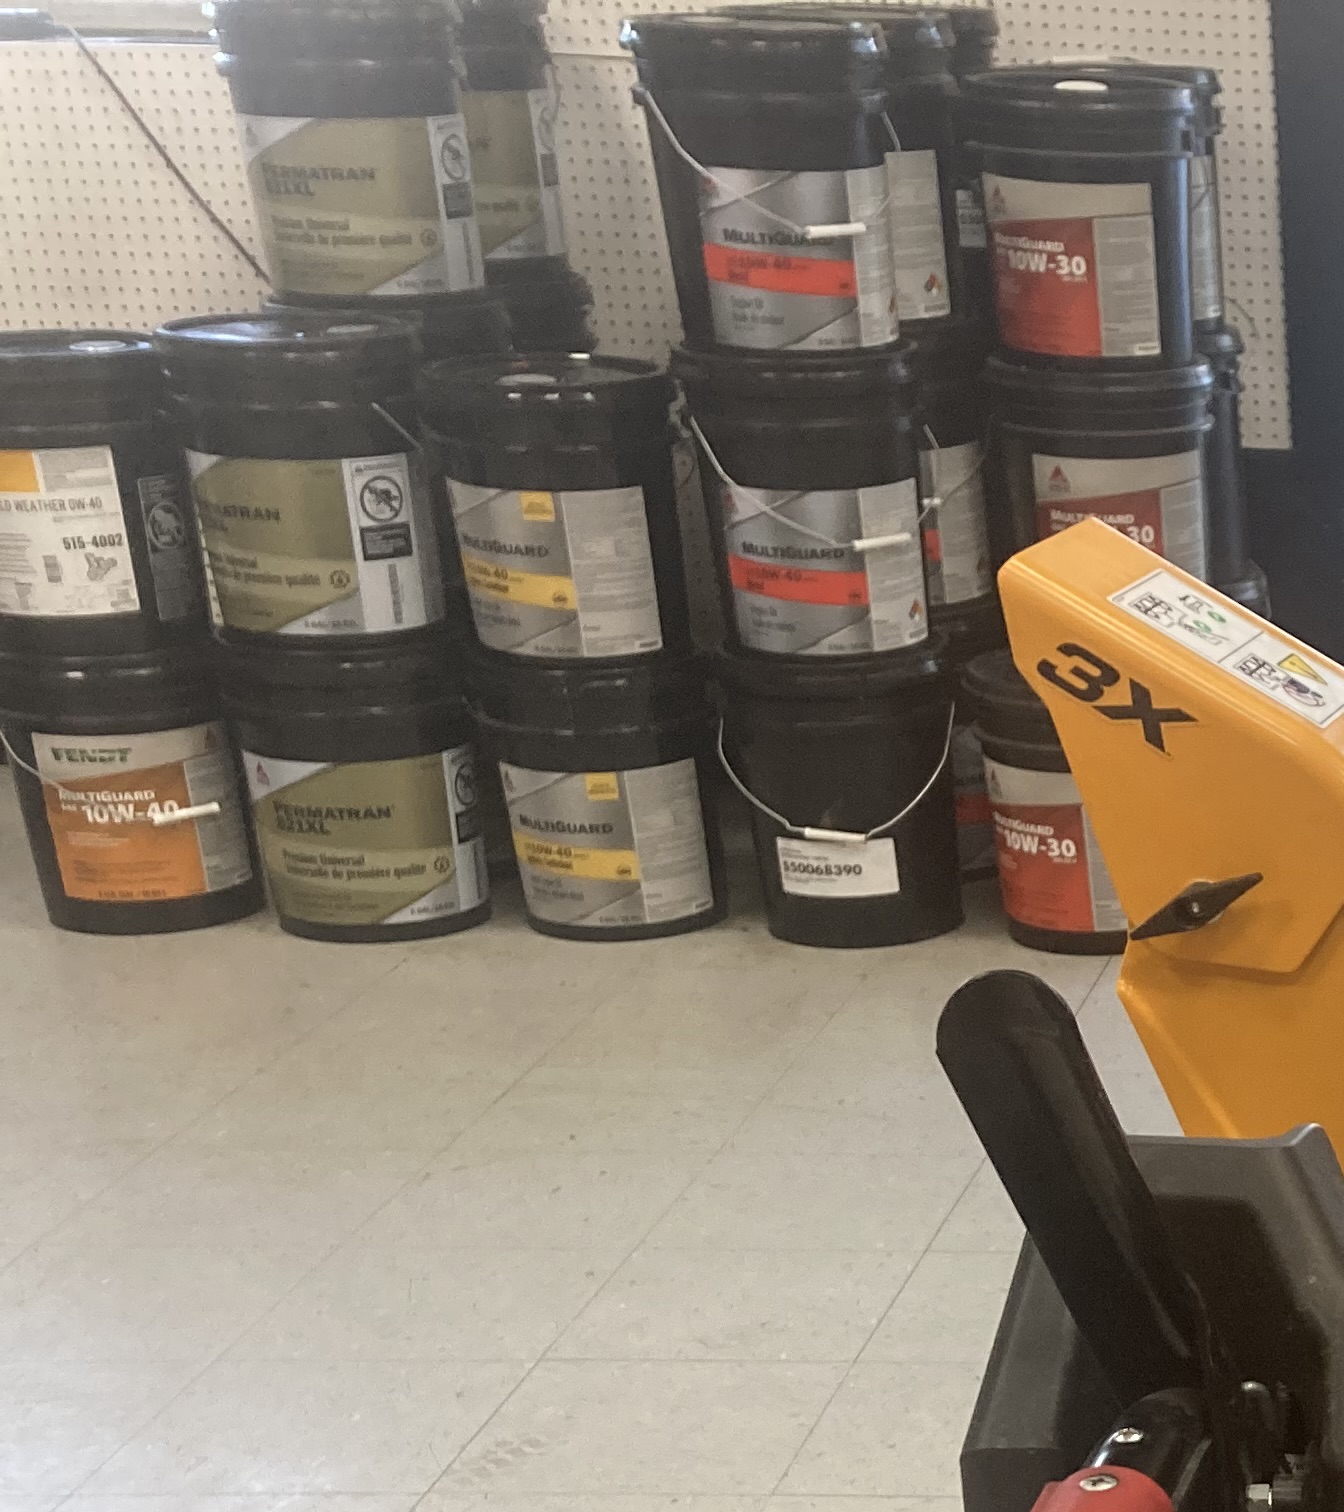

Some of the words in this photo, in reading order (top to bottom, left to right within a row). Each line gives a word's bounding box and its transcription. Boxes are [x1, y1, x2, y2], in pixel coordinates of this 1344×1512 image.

[1007, 250, 1088, 276] 10W-30
[14, 499, 67, 513] WEATHER
[62, 532, 124, 551] 515-4002
[1036, 642, 1200, 757] 3X
[81, 799, 180, 825] 10W-40
[518, 813, 614, 834] MULTIGUARD
[1003, 830, 1077, 858] 10W-30
